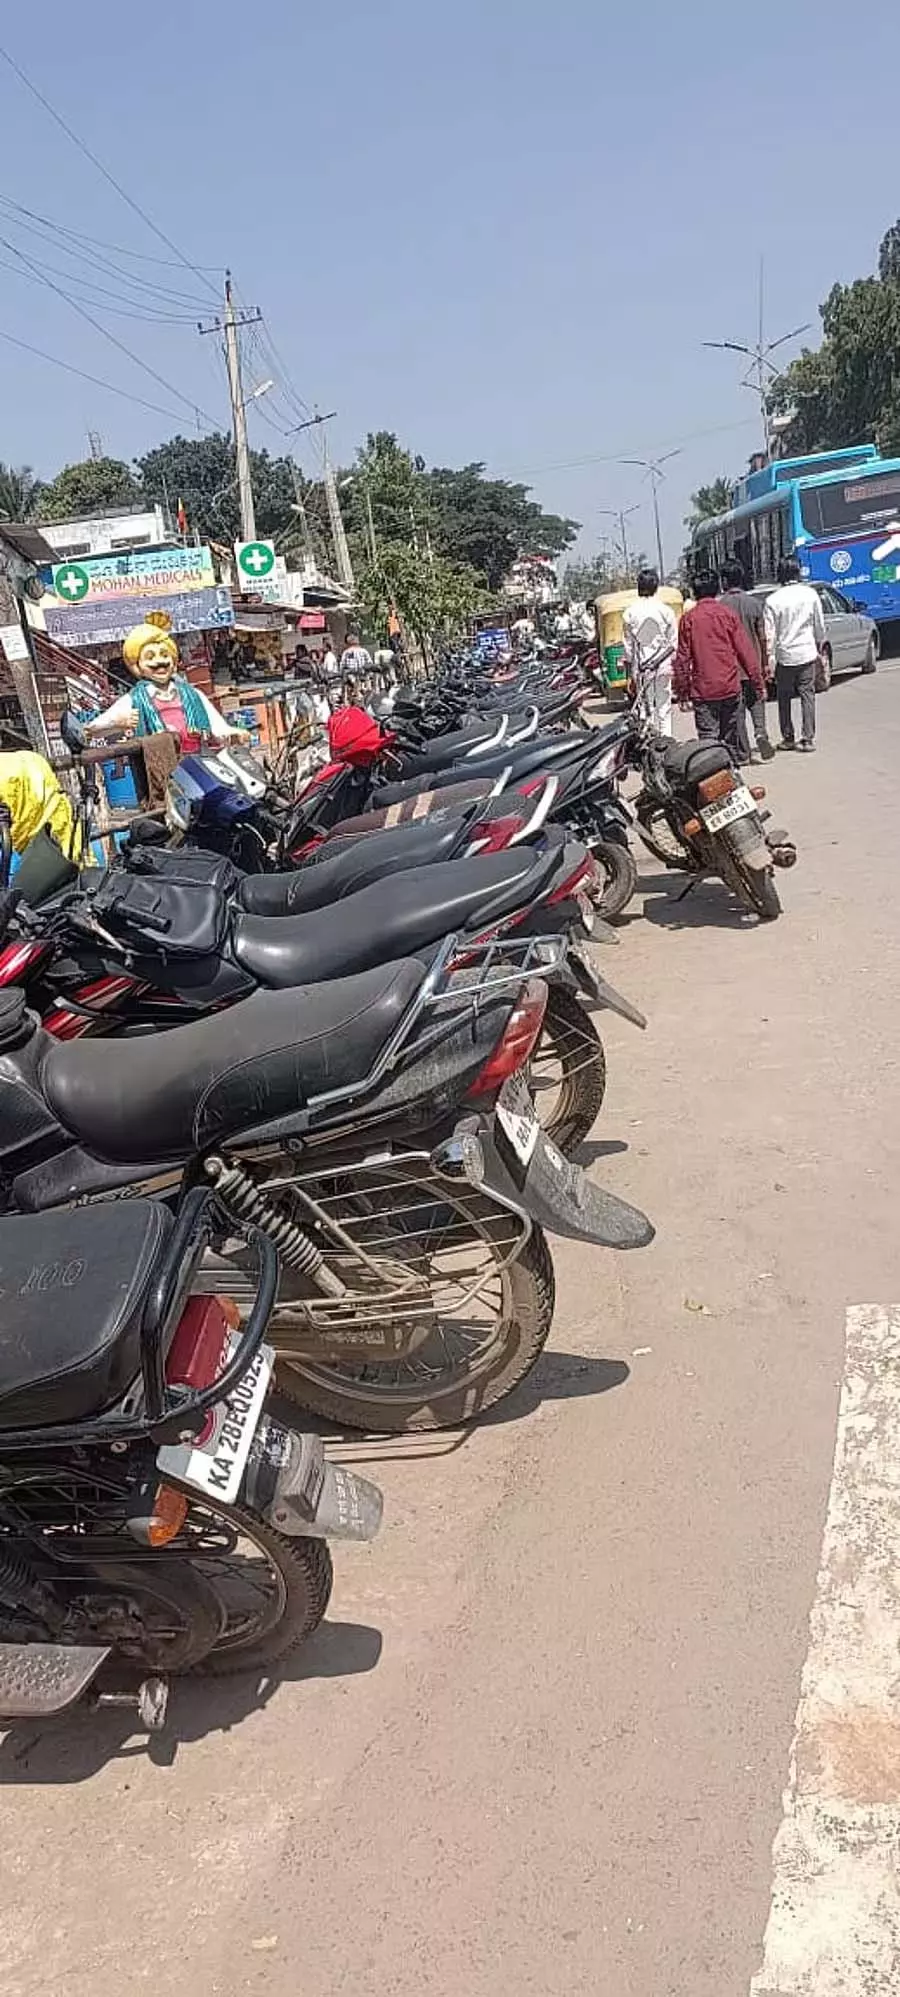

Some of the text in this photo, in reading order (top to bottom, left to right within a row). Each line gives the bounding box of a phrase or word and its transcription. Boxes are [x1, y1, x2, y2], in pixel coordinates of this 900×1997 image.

[91, 568, 202, 593] MOHAN MEDICALS
[207, 1456, 234, 1491] KA
